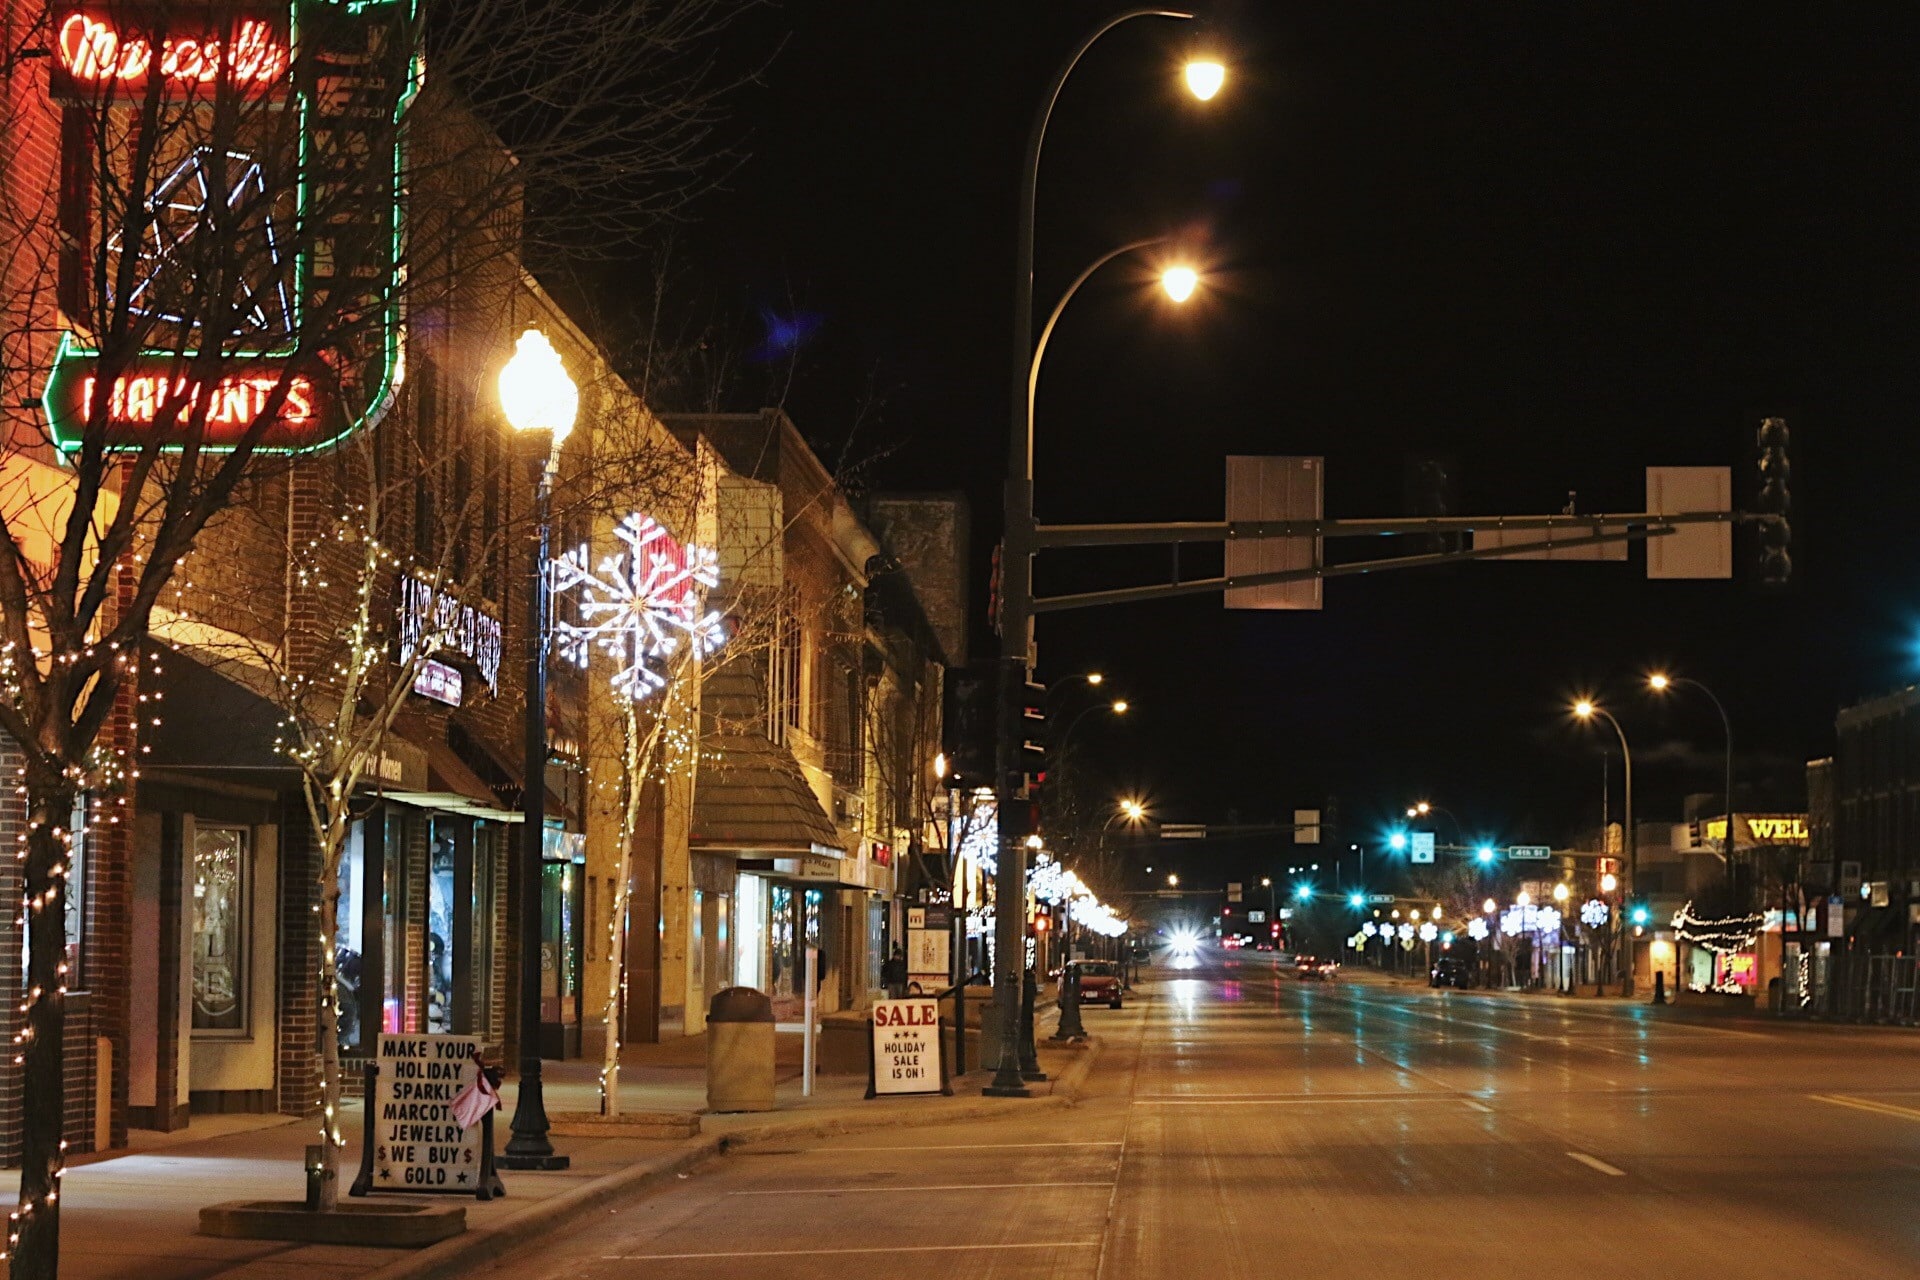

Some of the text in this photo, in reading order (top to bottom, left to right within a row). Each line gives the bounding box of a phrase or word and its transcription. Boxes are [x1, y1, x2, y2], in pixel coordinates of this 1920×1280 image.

[1515, 848, 1543, 857] 4th St
[875, 1004, 936, 1027] SALE
[383, 1040, 476, 1060] MAKE YOUR
[884, 1042, 925, 1054] HOLIDAY
[893, 1055, 919, 1066] SALE
[395, 1061, 462, 1080] HOLIDAY
[892, 1067, 902, 1079] IS
[383, 1103, 457, 1122] MARCOT
[389, 1124, 464, 1143] JEWELRY
[391, 1146, 415, 1163] WE
[429, 1148, 460, 1164] BUY
[405, 1167, 446, 1185] GOLD
